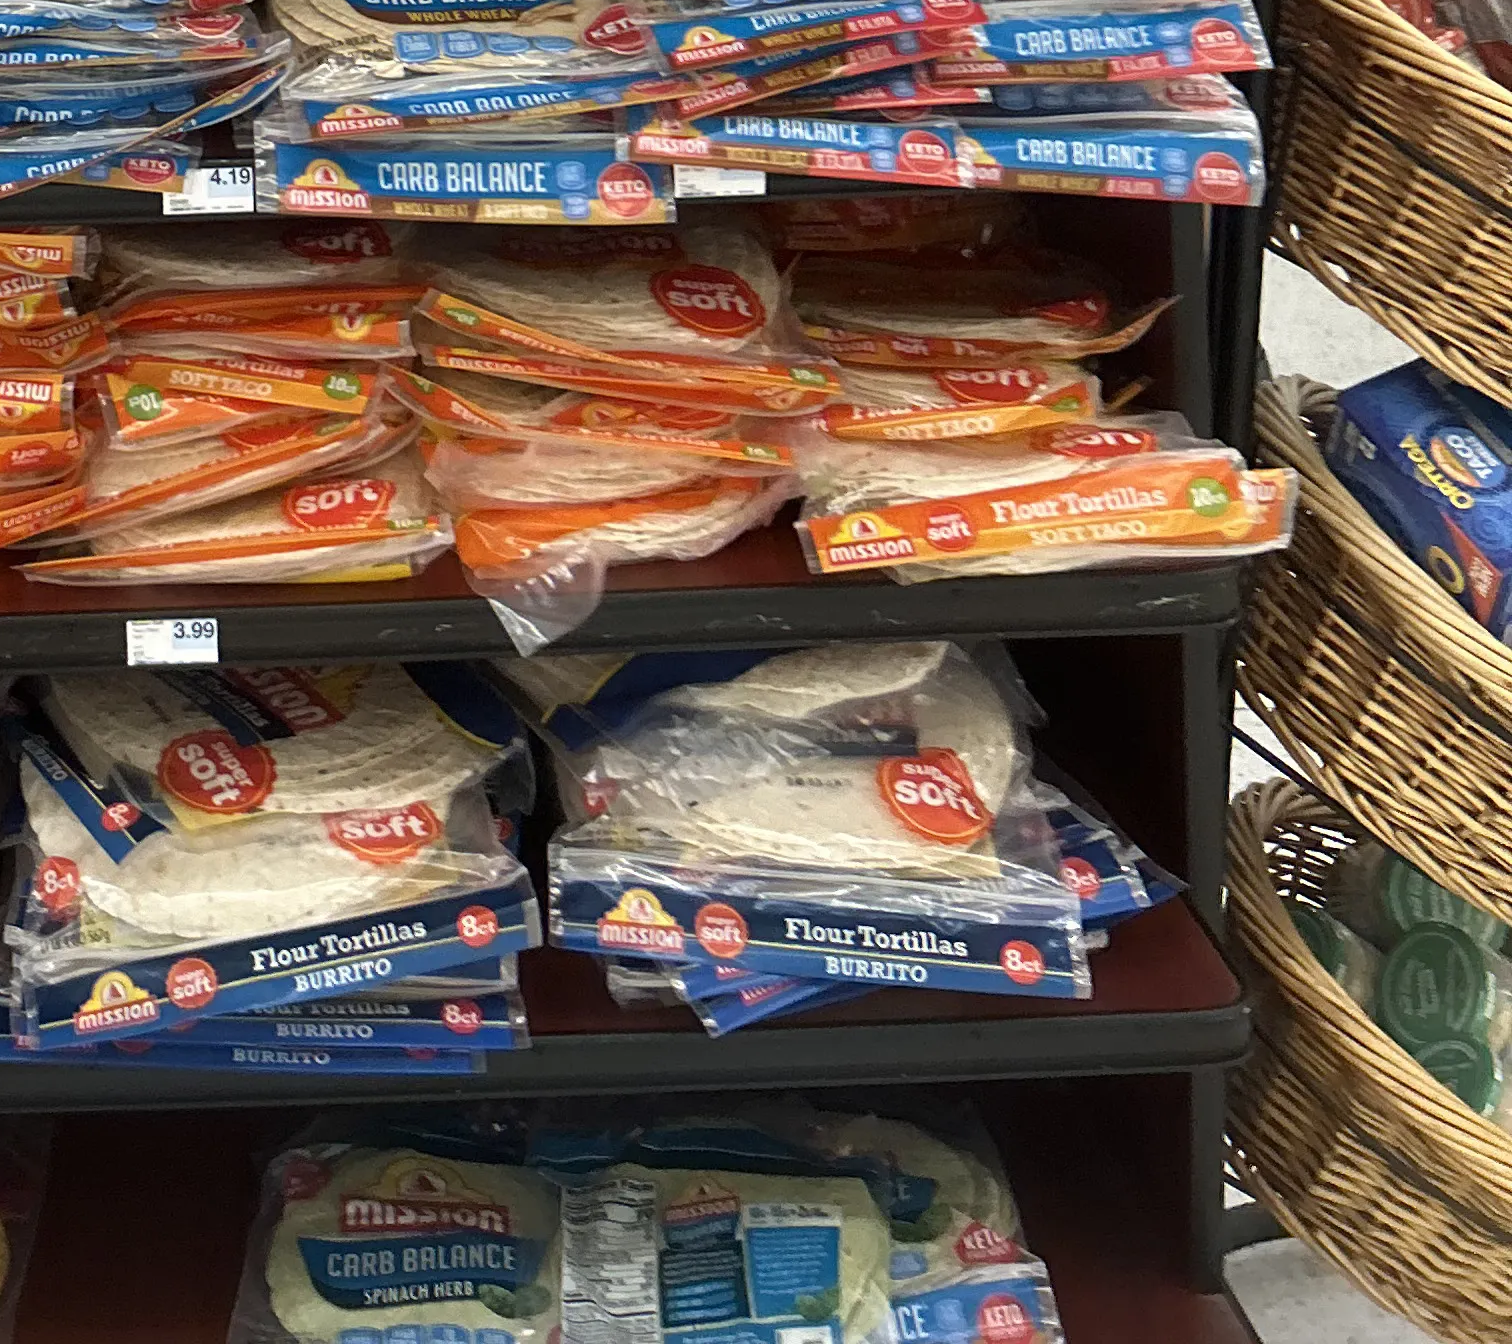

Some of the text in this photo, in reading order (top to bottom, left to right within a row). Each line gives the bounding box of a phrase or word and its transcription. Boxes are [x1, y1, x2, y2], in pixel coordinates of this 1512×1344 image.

[210, 167, 251, 186] 4.19
[378, 163, 549, 193] CARB BALANCE
[673, 277, 737, 296] super
[668, 289, 753, 317] soft
[990, 487, 1168, 523] Flour Tortillas
[172, 620, 216, 641] 3.99
[177, 743, 243, 804] soft
[250, 919, 428, 971] Flour Tortillas
[785, 918, 968, 958] Flour Tortillas
[295, 959, 393, 993] BURRITO
[825, 954, 928, 983] BURRITO
[326, 1244, 516, 1279] CARB BALANCE
[363, 1281, 475, 1304] SPINACH HERB
